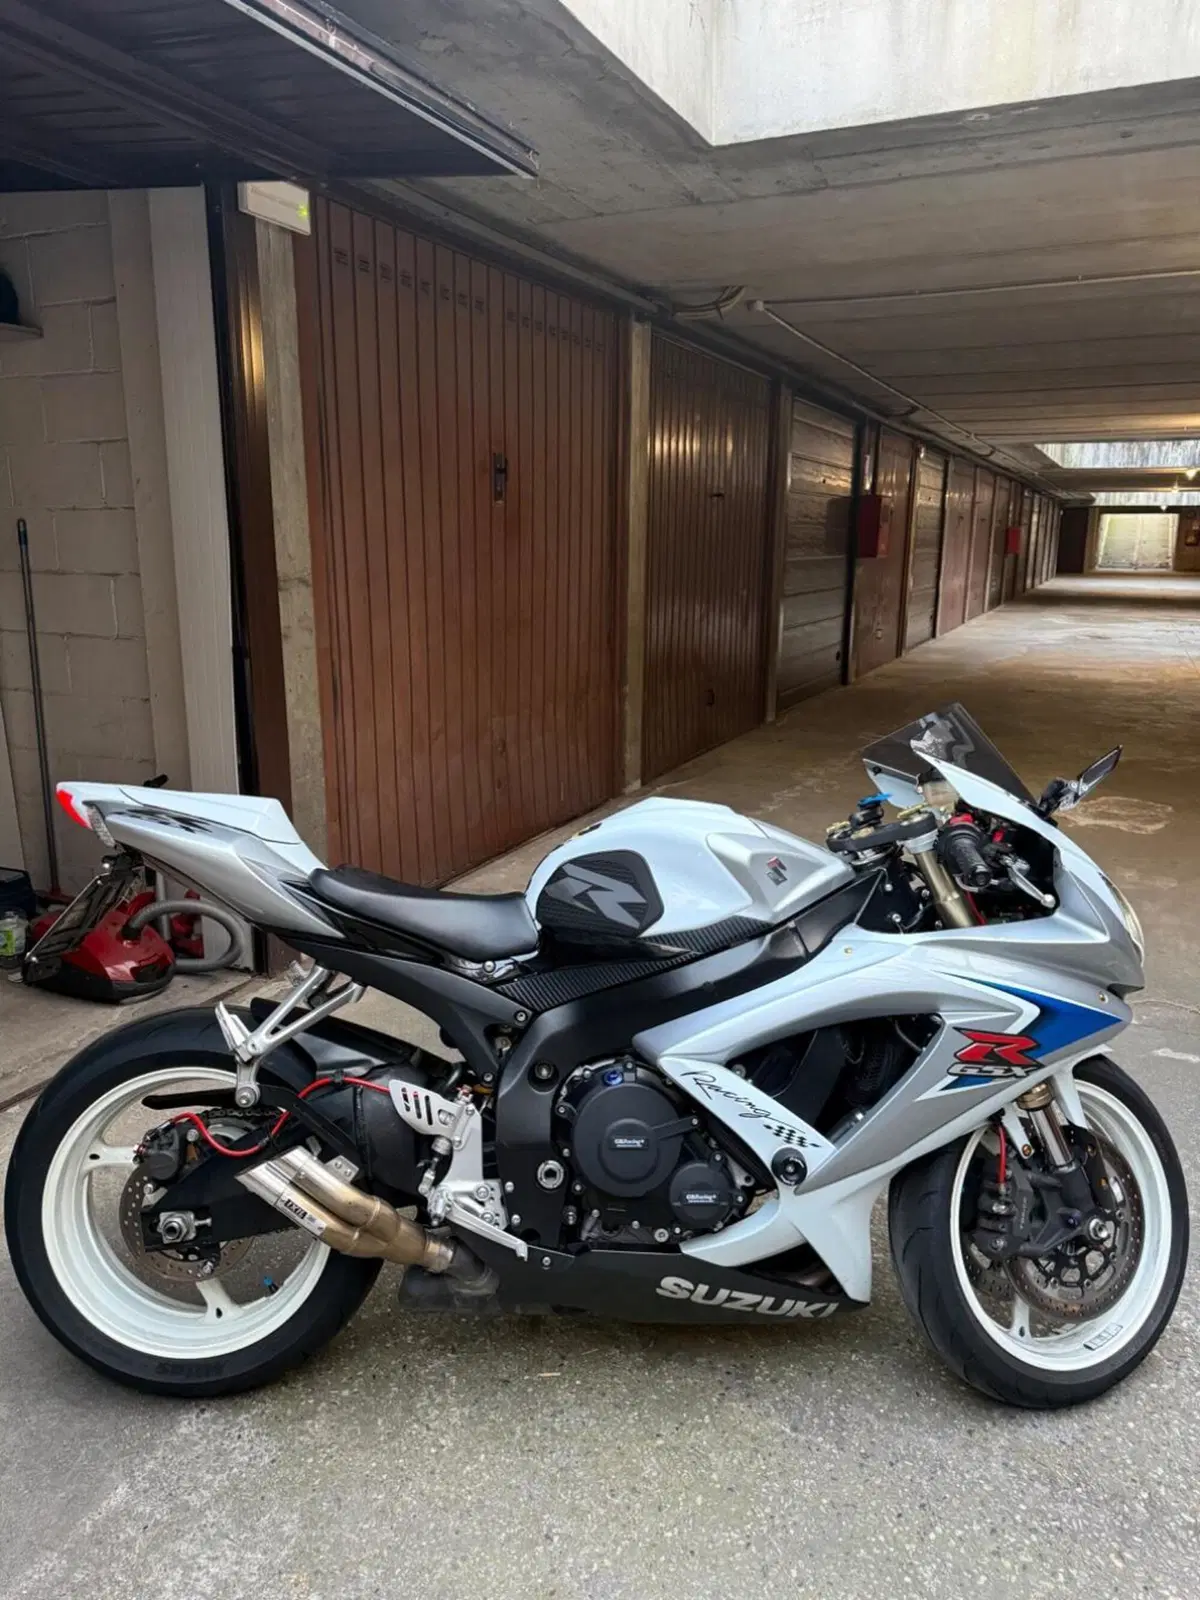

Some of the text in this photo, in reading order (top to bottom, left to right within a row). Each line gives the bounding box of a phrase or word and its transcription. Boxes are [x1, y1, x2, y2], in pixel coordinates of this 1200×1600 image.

[947, 1062, 1040, 1078] GSX
[680, 1070, 805, 1135] Racing
[656, 1275, 839, 1318] SUZUKI
